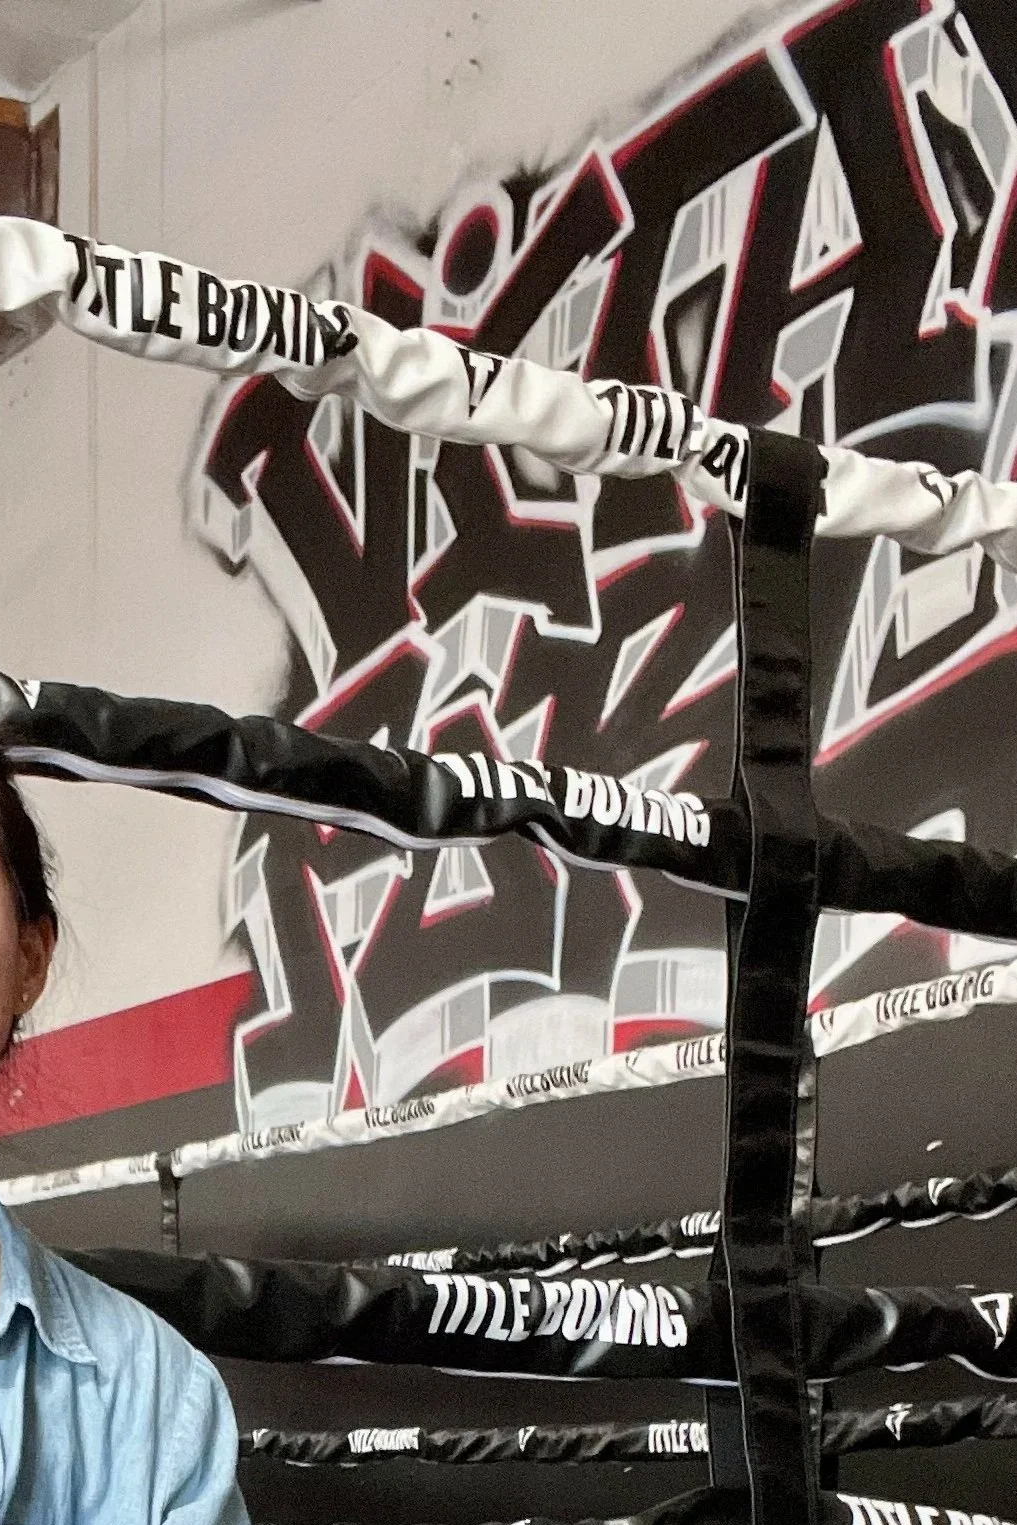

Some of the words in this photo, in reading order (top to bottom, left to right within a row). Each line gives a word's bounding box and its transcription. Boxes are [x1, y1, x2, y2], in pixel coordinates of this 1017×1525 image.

[64, 233, 184, 340] TITLE
[197, 270, 360, 367] BOXING
[563, 766, 711, 848] BOXING
[675, 1036, 715, 1070] TITLE
[423, 1274, 531, 1342] TITLE
[534, 1278, 688, 1348] BOXING
[648, 1421, 689, 1453] TITLE
